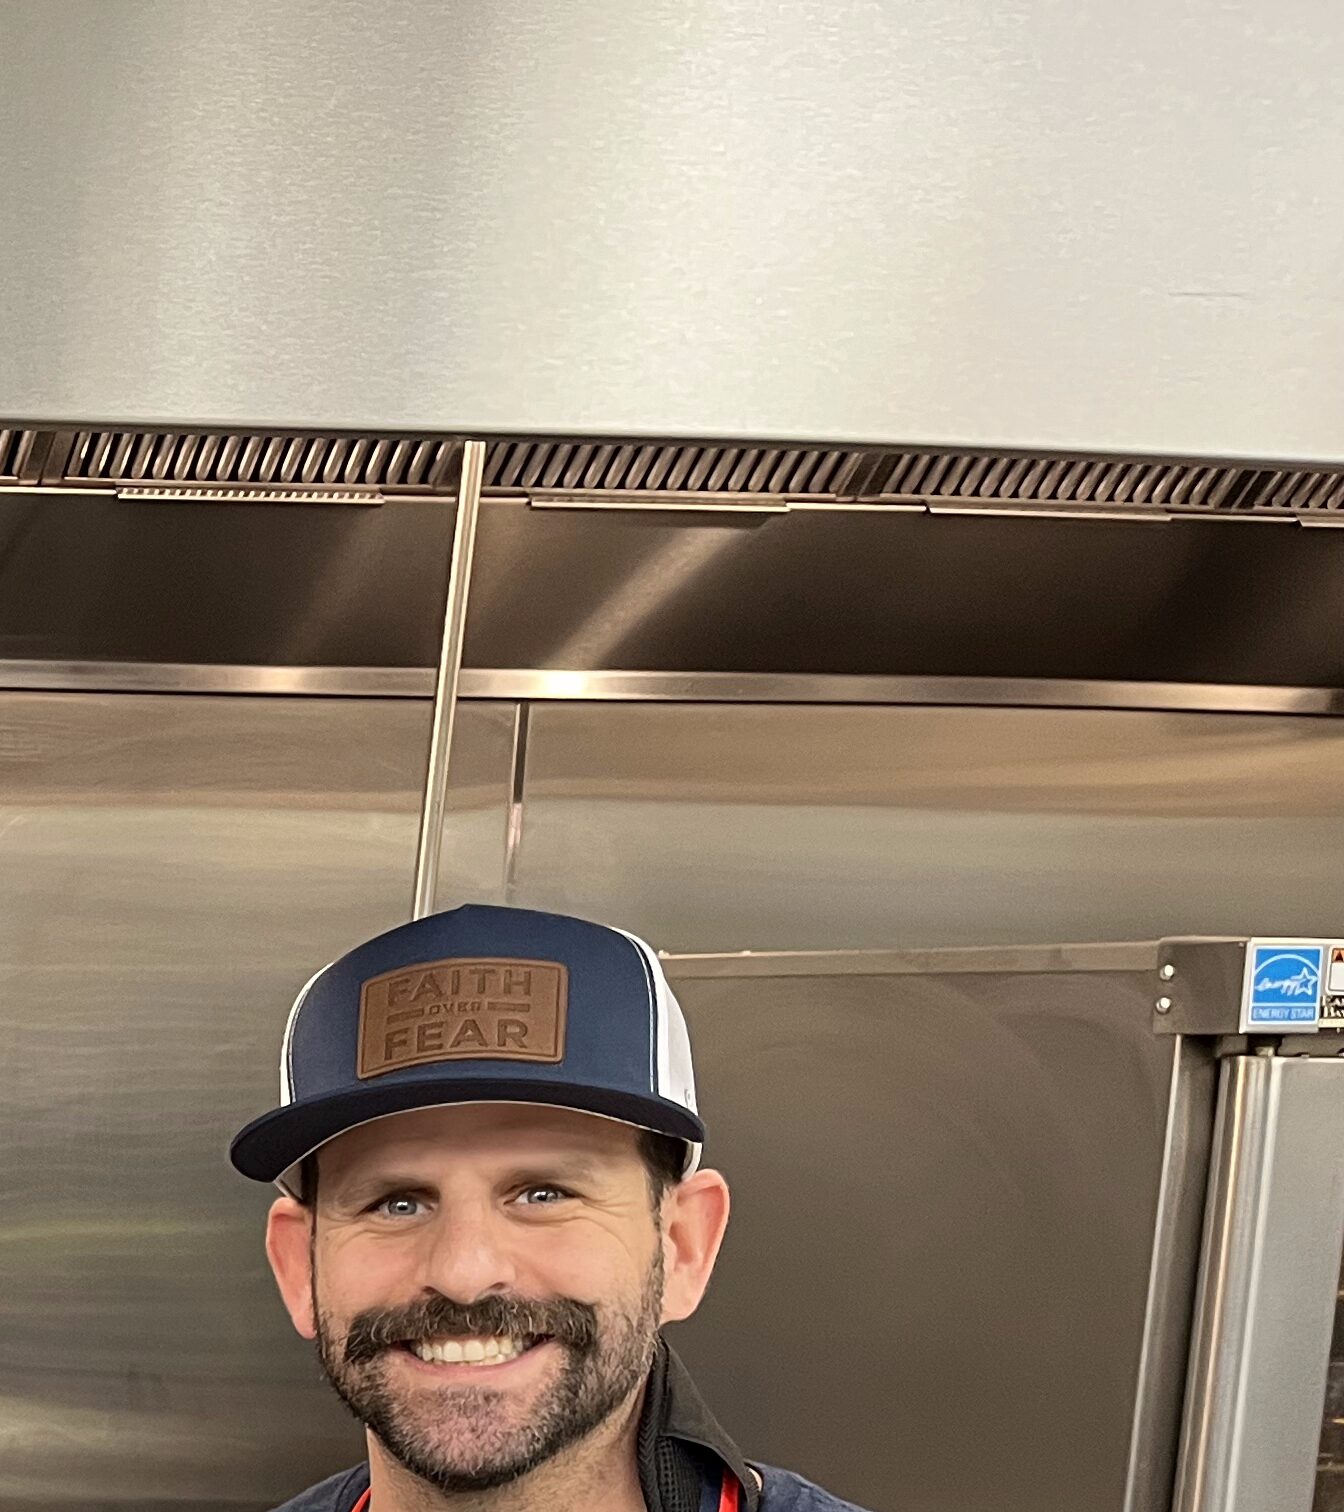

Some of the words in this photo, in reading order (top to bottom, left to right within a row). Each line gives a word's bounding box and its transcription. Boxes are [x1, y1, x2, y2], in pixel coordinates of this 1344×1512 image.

[388, 968, 531, 1006] FAITH
[428, 1001, 482, 1016] OVER
[1253, 1007, 1289, 1019] ENERGY
[1289, 1007, 1314, 1019] STAR
[383, 1018, 529, 1061] FEAR
